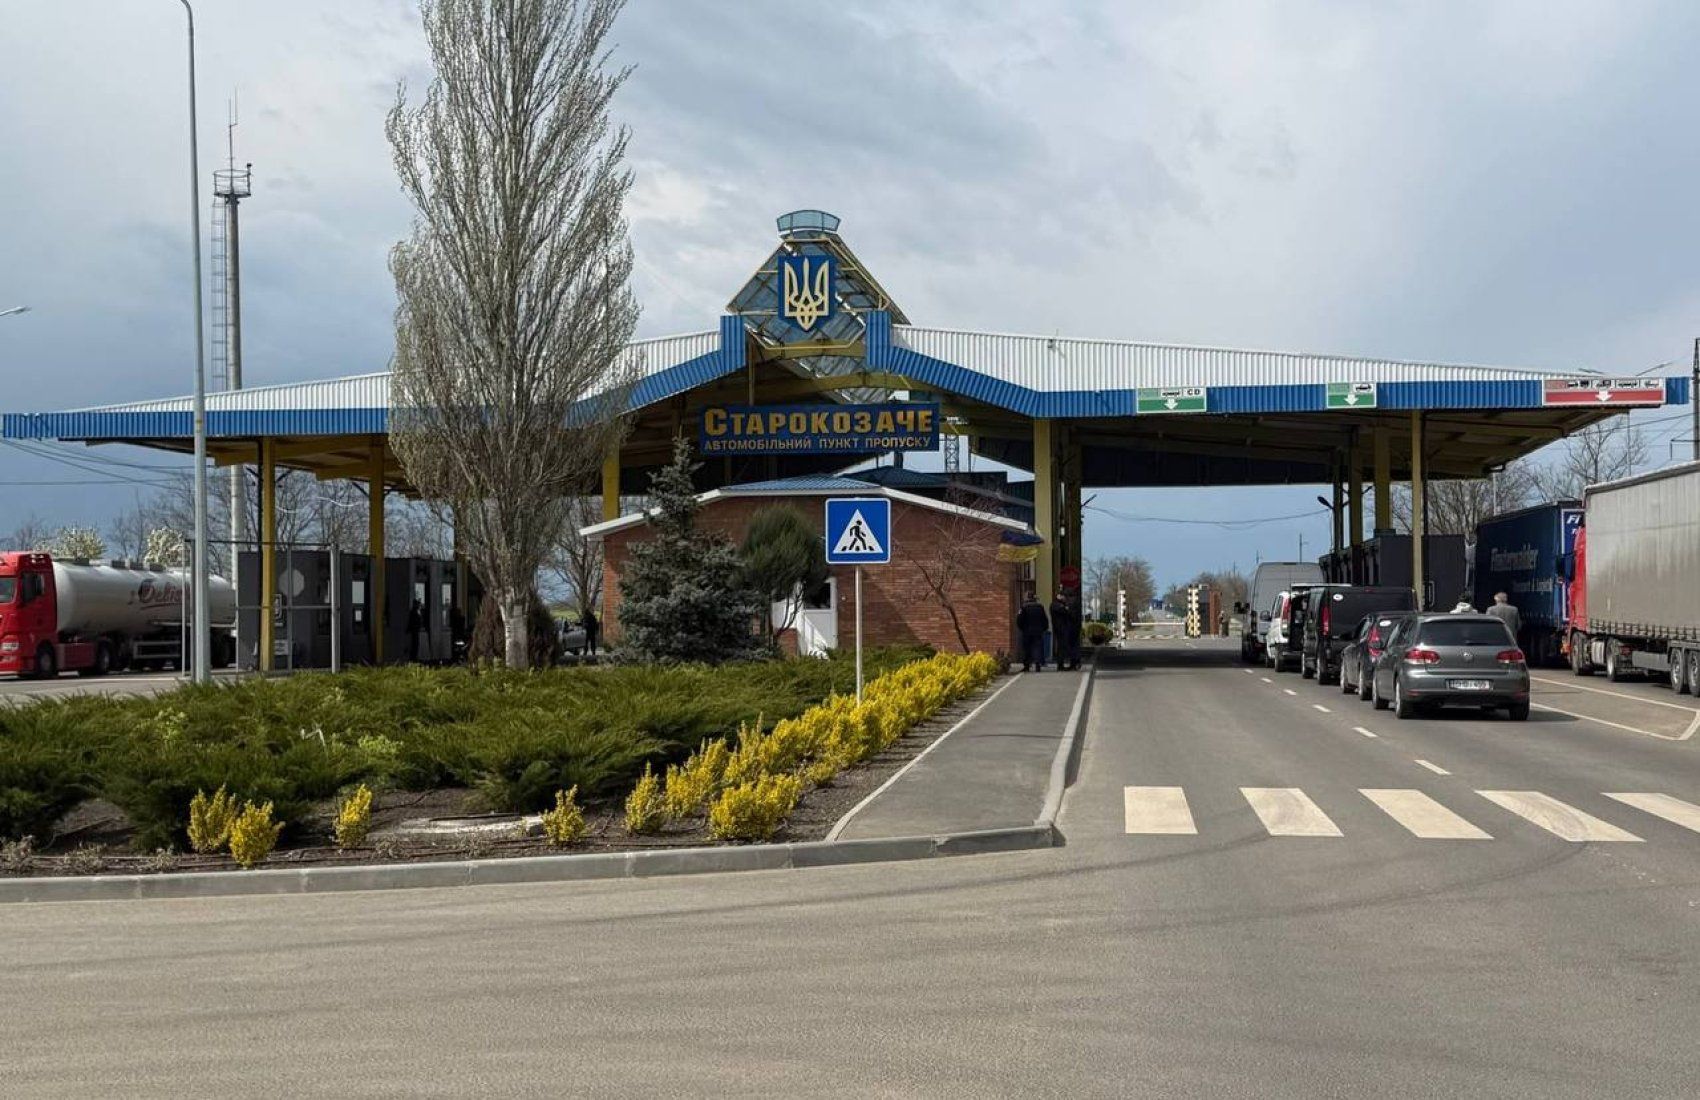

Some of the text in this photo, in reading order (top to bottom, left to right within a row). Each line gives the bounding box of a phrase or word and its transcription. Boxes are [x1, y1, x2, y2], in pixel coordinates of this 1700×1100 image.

[704, 436, 931, 450] АВТОМОБІЛЬНИЙ ПУНКТ ПРОПУСКУ
